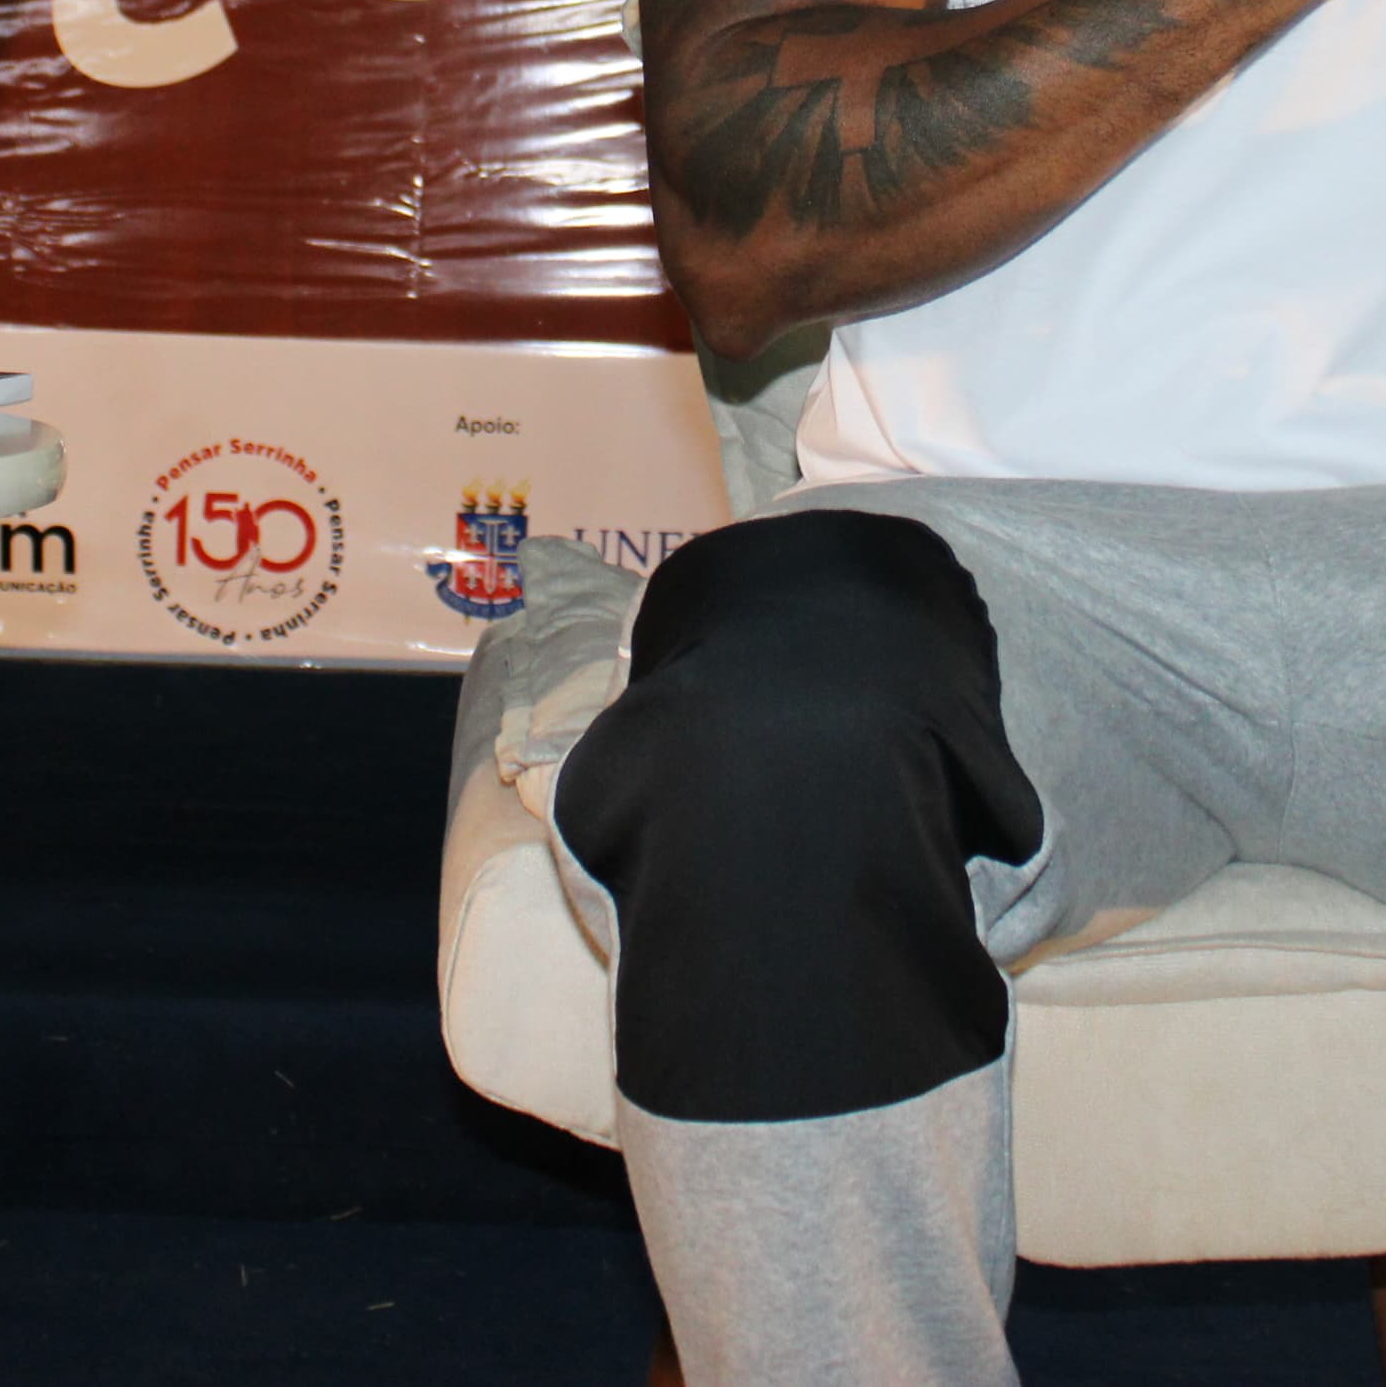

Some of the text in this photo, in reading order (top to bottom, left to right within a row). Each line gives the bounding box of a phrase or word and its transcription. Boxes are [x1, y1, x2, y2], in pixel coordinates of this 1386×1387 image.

[455, 416, 520, 437] Apoio:
[230, 437, 318, 484] Serrinha
[136, 510, 170, 602] Serrinha
[164, 491, 317, 573] 150
[573, 528, 706, 569] UNE
[260, 580, 338, 642] Serrinha
